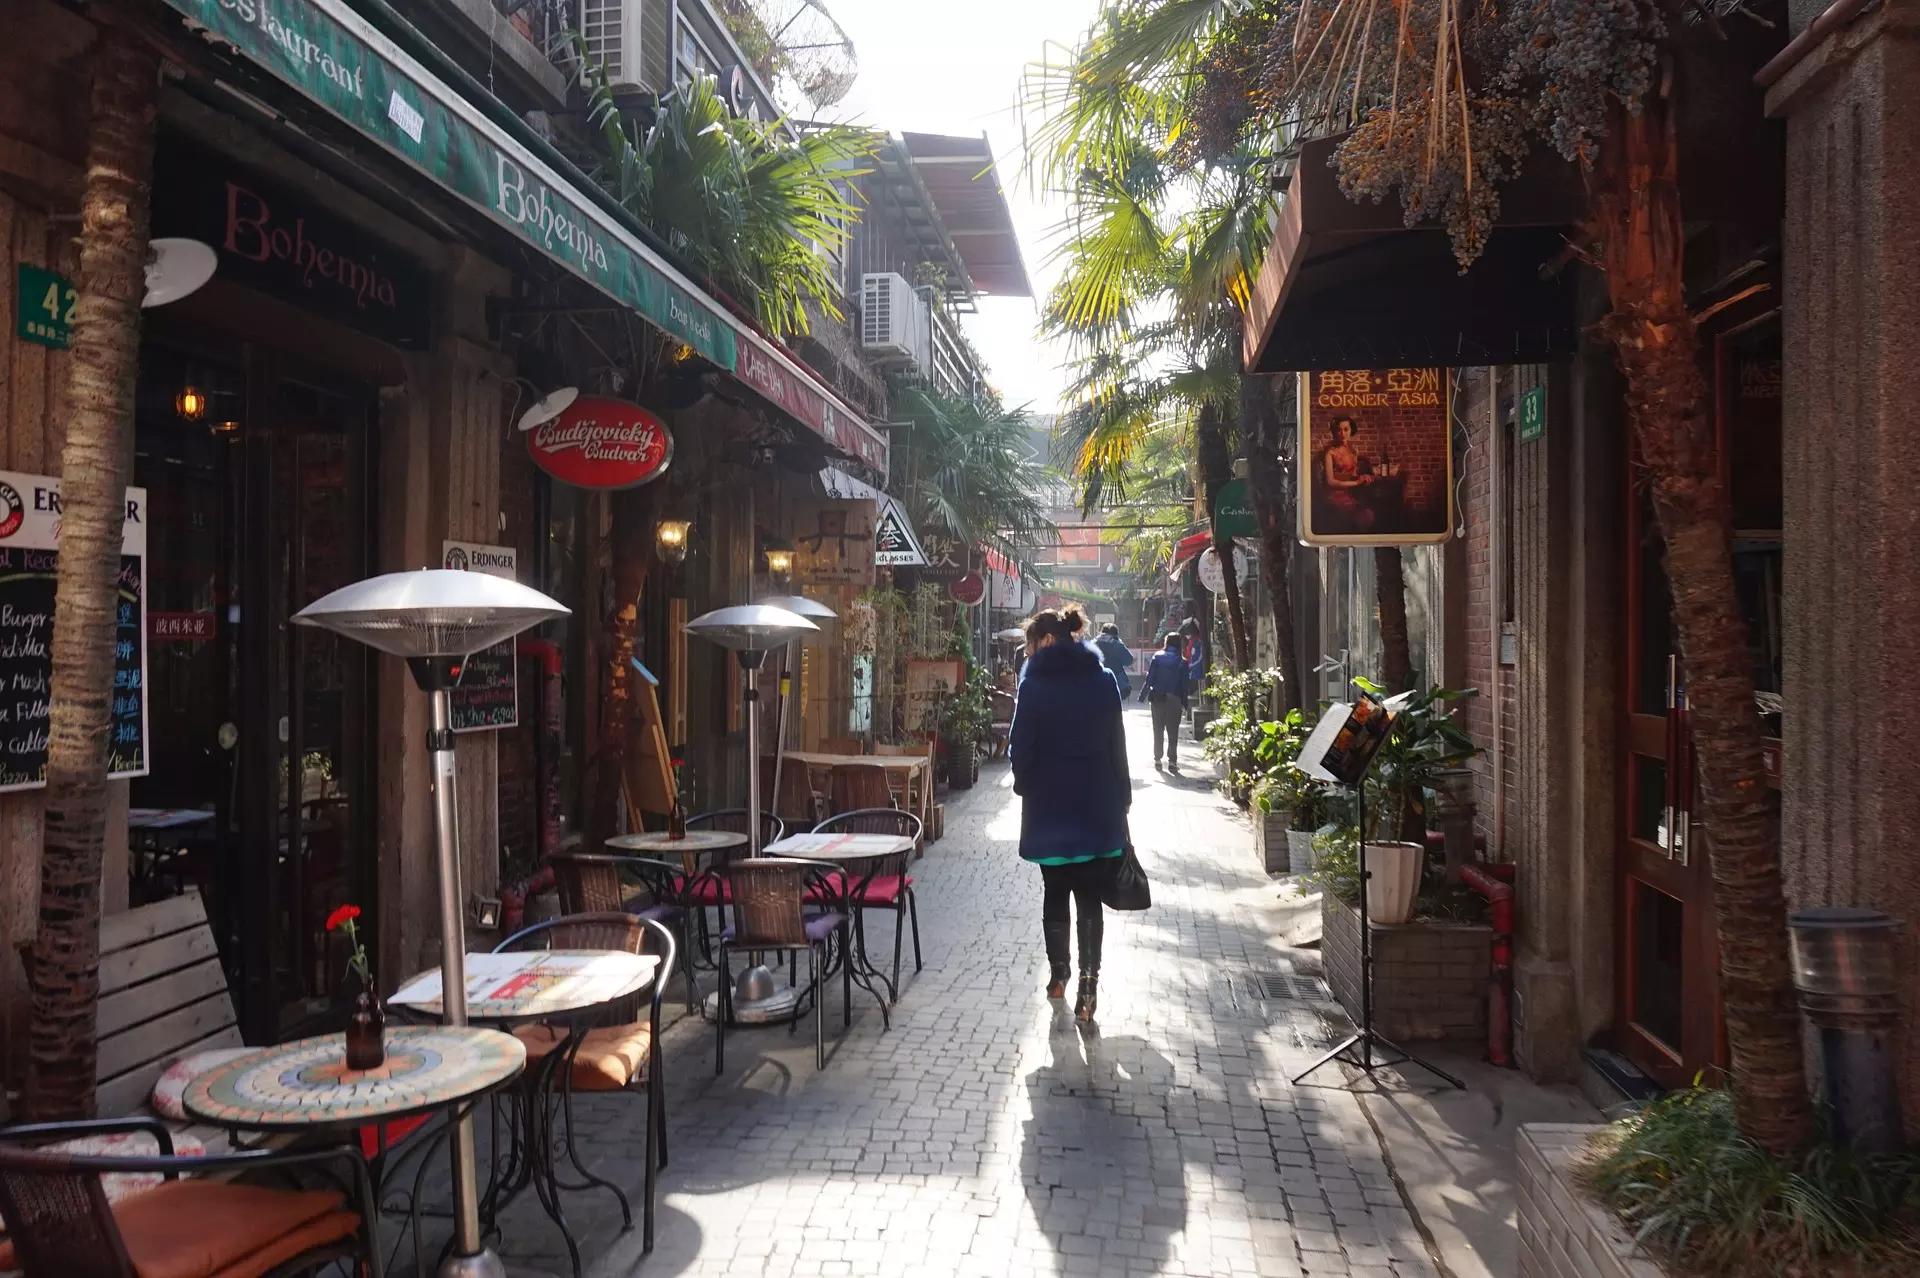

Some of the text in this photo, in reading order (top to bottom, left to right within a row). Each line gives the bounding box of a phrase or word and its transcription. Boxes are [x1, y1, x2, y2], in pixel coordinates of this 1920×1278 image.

[495, 150, 608, 273] Bohemia
[223, 180, 397, 308] Bohemia
[42, 282, 79, 324] 42
[670, 297, 688, 326] bar
[1318, 393, 1440, 407] CORNER ASIA
[1526, 395, 1537, 423] 33
[584, 441, 650, 462] Budvar
[471, 551, 515, 570] ERDINGER
[2, 604, 47, 632] Burger
[155, 616, 206, 634] 波西米亚
